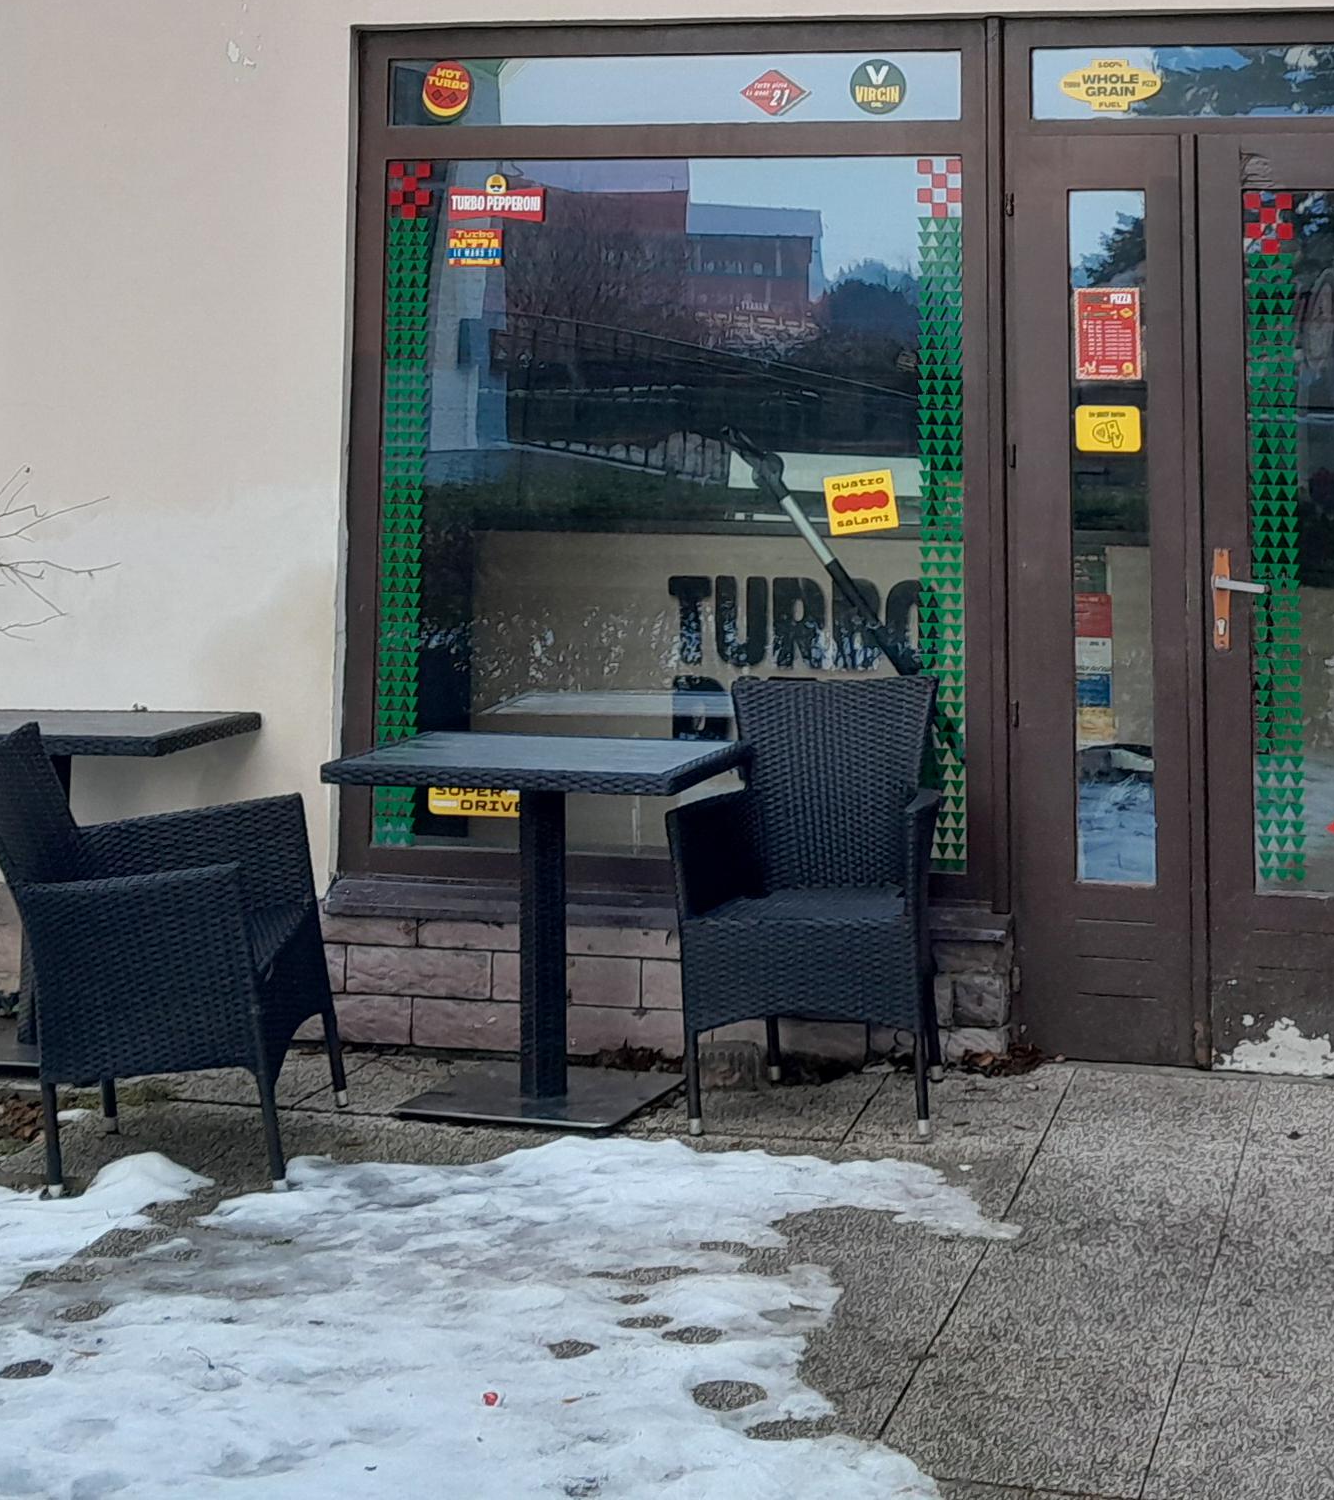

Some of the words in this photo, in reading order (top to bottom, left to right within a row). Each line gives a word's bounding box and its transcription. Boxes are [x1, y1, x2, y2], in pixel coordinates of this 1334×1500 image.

[436, 68, 463, 79] HOT
[866, 65, 889, 85] V
[1082, 73, 1139, 85] WHOLE
[427, 76, 469, 90] TURBO
[770, 88, 790, 106] 21
[855, 85, 900, 103] VIRGIN
[1085, 86, 1136, 97] GRAIN
[451, 195, 485, 211] TURBO
[486, 195, 541, 212] PEPPERONI
[832, 477, 884, 491] quatro
